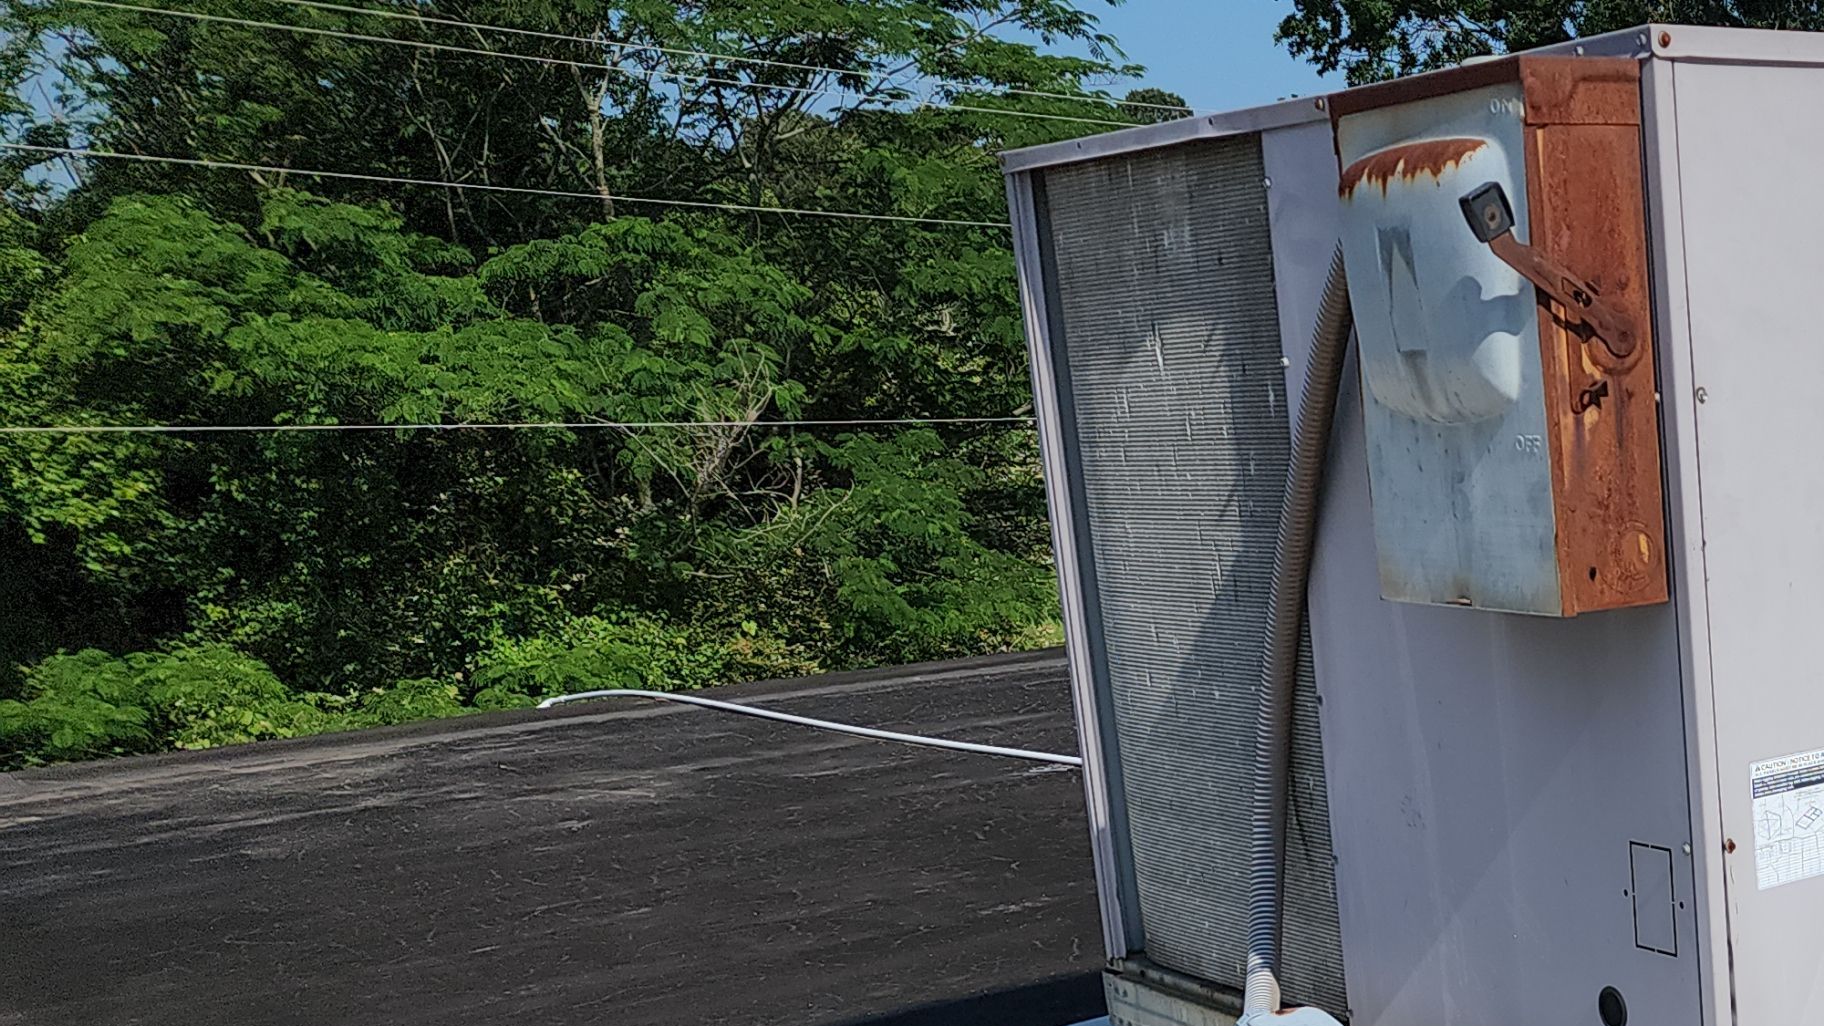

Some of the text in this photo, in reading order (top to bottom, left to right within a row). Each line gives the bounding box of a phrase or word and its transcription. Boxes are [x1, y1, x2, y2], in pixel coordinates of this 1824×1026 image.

[1489, 97, 1514, 115] ON
[1515, 434, 1541, 453] OFF
[1760, 760, 1787, 771] CAUTION
[1790, 755, 1810, 764] NOTICE
